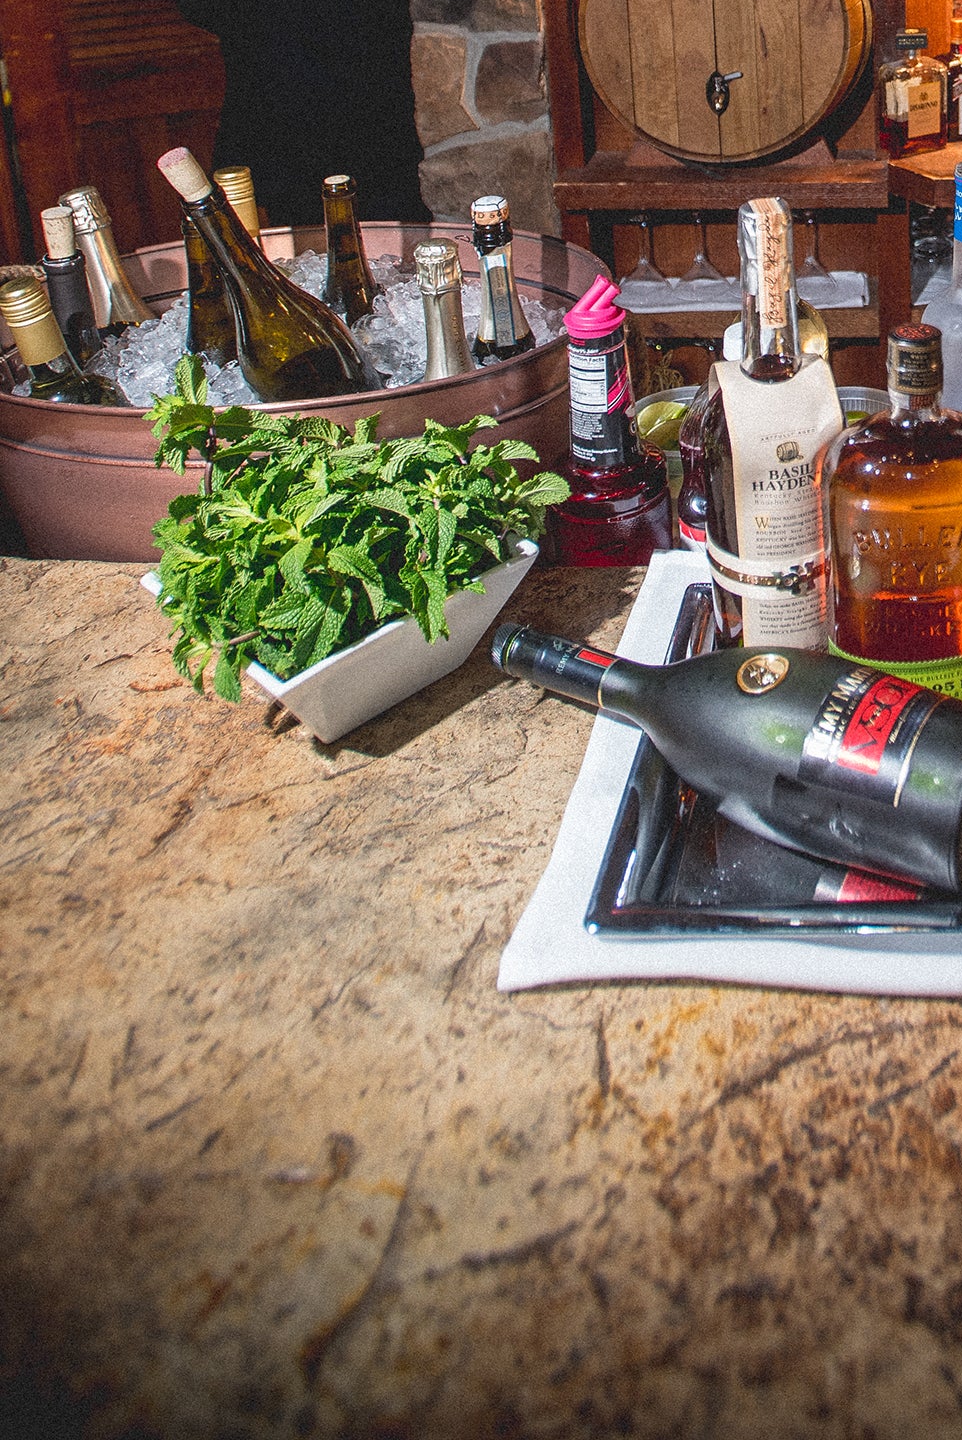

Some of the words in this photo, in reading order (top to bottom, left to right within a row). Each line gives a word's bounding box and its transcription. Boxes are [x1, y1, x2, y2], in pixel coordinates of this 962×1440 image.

[769, 463, 814, 480] BASIL
[754, 491, 791, 499] Kentucky
[890, 560, 952, 586] RYE
[910, 676, 925, 684] THE
